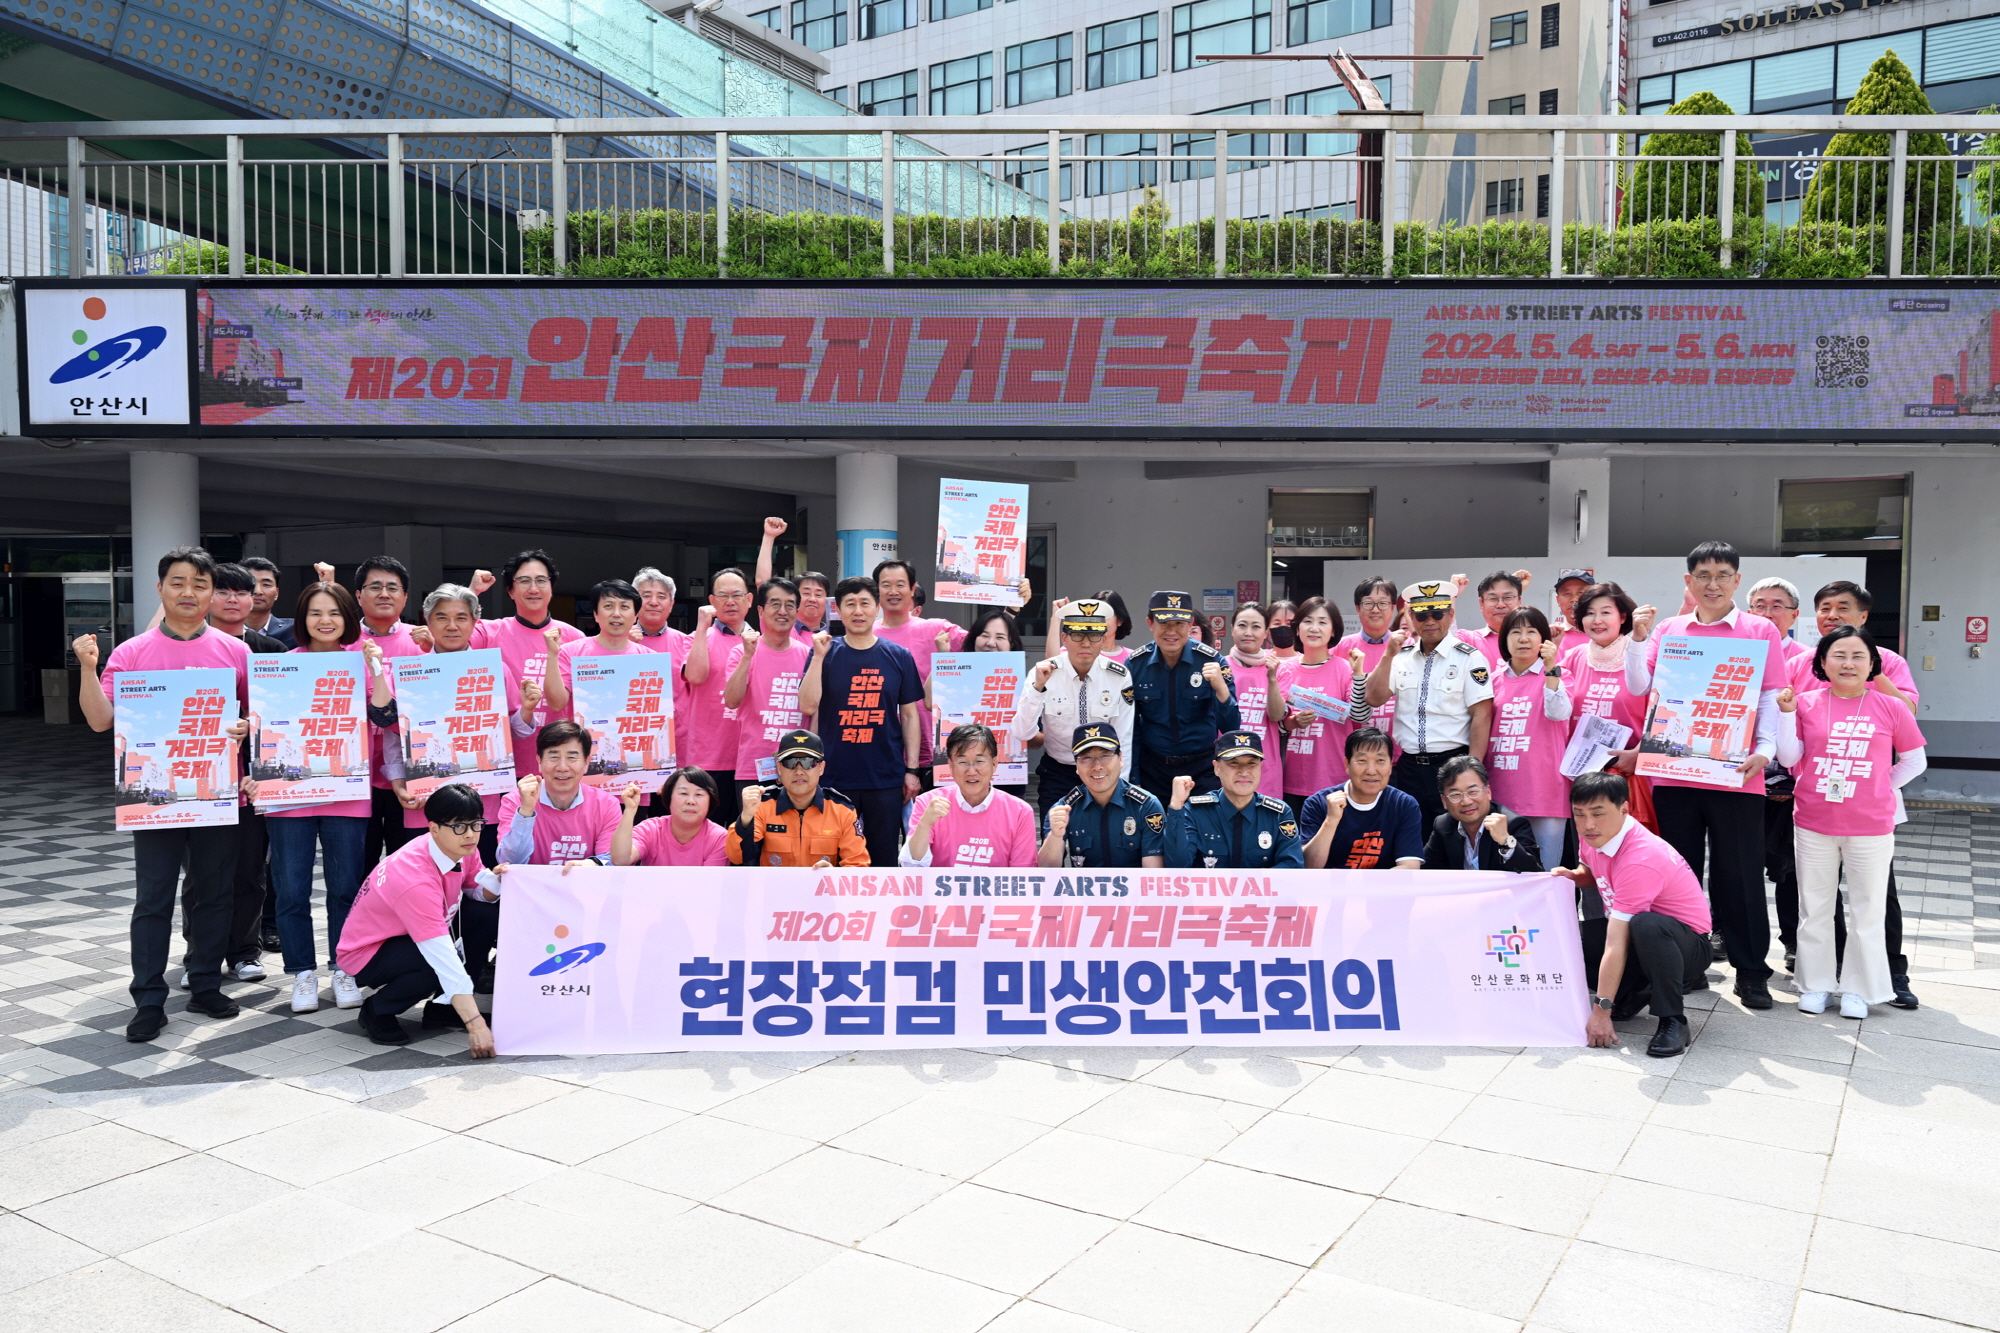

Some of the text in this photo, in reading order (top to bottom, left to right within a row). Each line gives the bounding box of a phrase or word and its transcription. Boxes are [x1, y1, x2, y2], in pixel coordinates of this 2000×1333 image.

[1657, 27, 1709, 43] 031.402.0116
[406, 307, 435, 321] 안산
[1424, 304, 1746, 321] ANSAN STREET ARTS FESTIVAL
[1422, 333, 1795, 360] 2024. 5. 4. SAT 5. 6. MON
[344, 356, 513, 400] 제20회
[70, 396, 148, 416] 안산시
[987, 504, 1020, 519] 안산
[984, 519, 1016, 536] 국제
[973, 536, 1019, 552] 거리극
[977, 552, 1008, 569] 축제
[399, 669, 424, 677] STREET
[1712, 664, 1755, 682] 안산
[314, 677, 356, 696] 안산
[456, 675, 495, 694] 안산
[628, 678, 664, 696] 안산
[850, 676, 884, 691] 안산
[983, 675, 1018, 691] 안산
[1586, 683, 1620, 699] 안산
[1705, 682, 1747, 701] 국제
[182, 696, 226, 716] 안산
[310, 697, 352, 716] 국제
[455, 694, 492, 713] 국제
[626, 697, 660, 714] 국제
[768, 694, 799, 710] 국제
[847, 692, 880, 708] 국제
[980, 693, 1014, 708] 국제
[759, 710, 802, 726] 거리극
[838, 710, 885, 726] 거리극
[1501, 702, 1532, 718] 안산
[1691, 700, 1748, 720] 거리극
[178, 717, 221, 737] 국제
[298, 717, 358, 737] 거리극
[444, 712, 500, 735] 거리극
[615, 715, 666, 734] 거리극
[1499, 719, 1527, 735] 국제
[1693, 720, 1730, 740] 축제
[1830, 721, 1875, 738] 안산
[452, 734, 489, 753] 축제
[621, 735, 654, 753] 축제
[841, 728, 874, 743] 축제
[1490, 736, 1531, 752] 거리극
[165, 737, 228, 759] 거리극
[305, 738, 344, 757] 축제
[1287, 738, 1314, 755] 축제
[1825, 739, 1870, 758] 국제
[172, 760, 213, 779] 축제
[1493, 755, 1519, 770] 축제
[1812, 757, 1873, 779] 거리극
[551, 841, 588, 858] 안산
[956, 844, 994, 863] 안산
[1350, 838, 1384, 854] 안산
[814, 876, 1279, 897] ANSAN STREET ARTS FESTIVAL
[766, 910, 874, 942] 제20회
[1471, 972, 1563, 986] 안산문화재단
[541, 984, 591, 996] 안산시
[678, 956, 1400, 1037] 현장점검 민생안전회의
